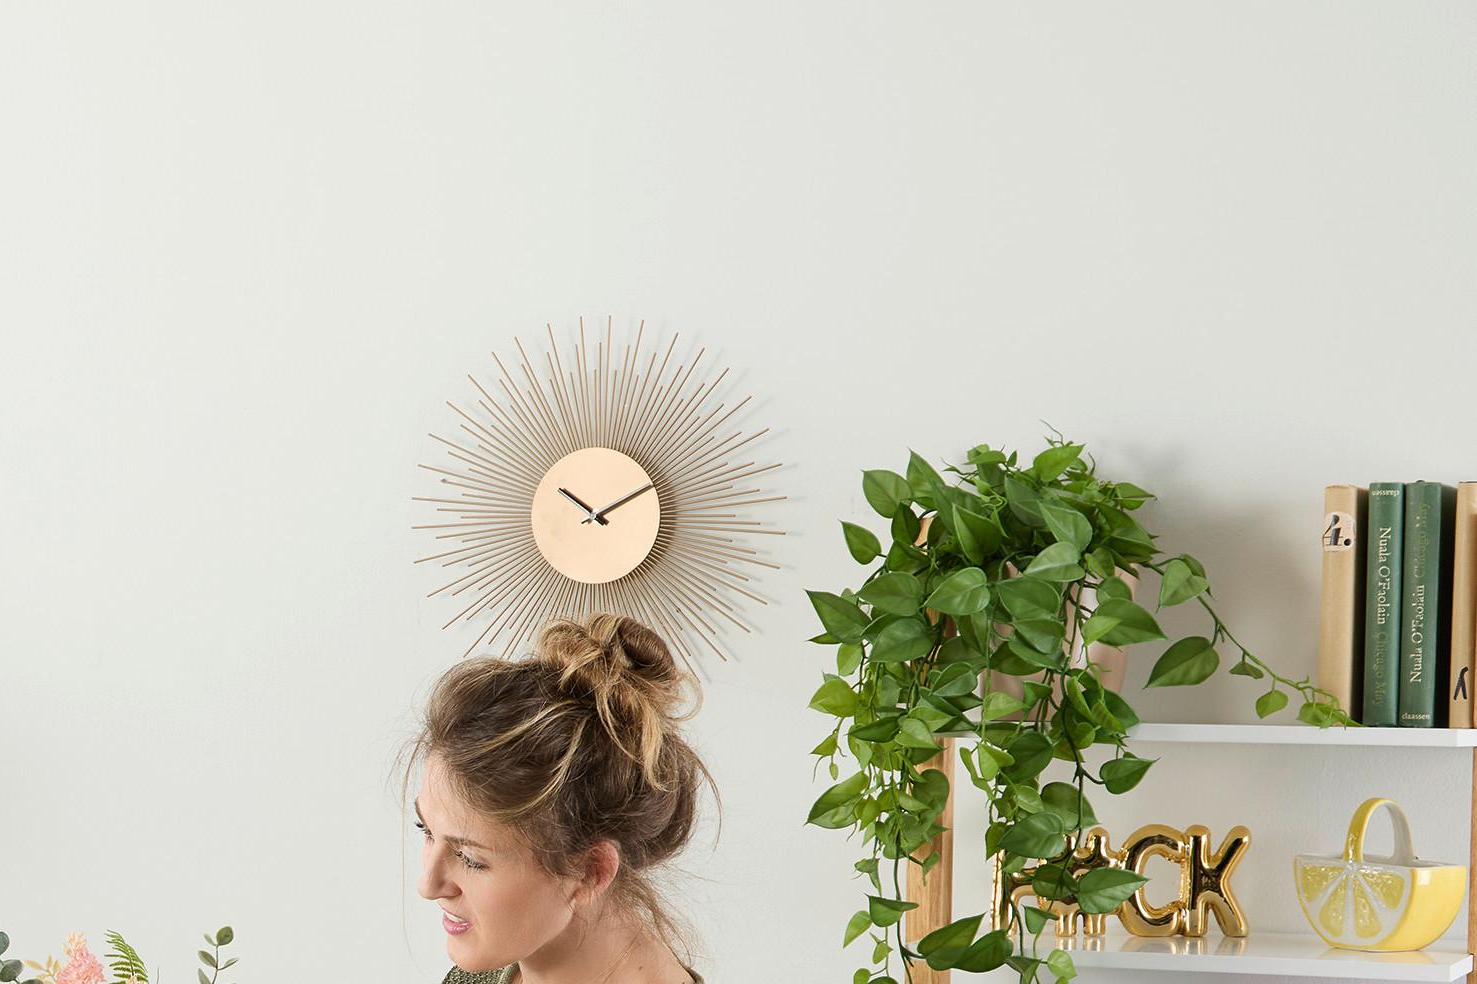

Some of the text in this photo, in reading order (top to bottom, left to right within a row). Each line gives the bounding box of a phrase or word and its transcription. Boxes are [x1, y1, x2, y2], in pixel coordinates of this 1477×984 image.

[1378, 527, 1392, 562] Nuala
[1409, 649, 1423, 683] Nuala
[1401, 711, 1431, 720] claassen
